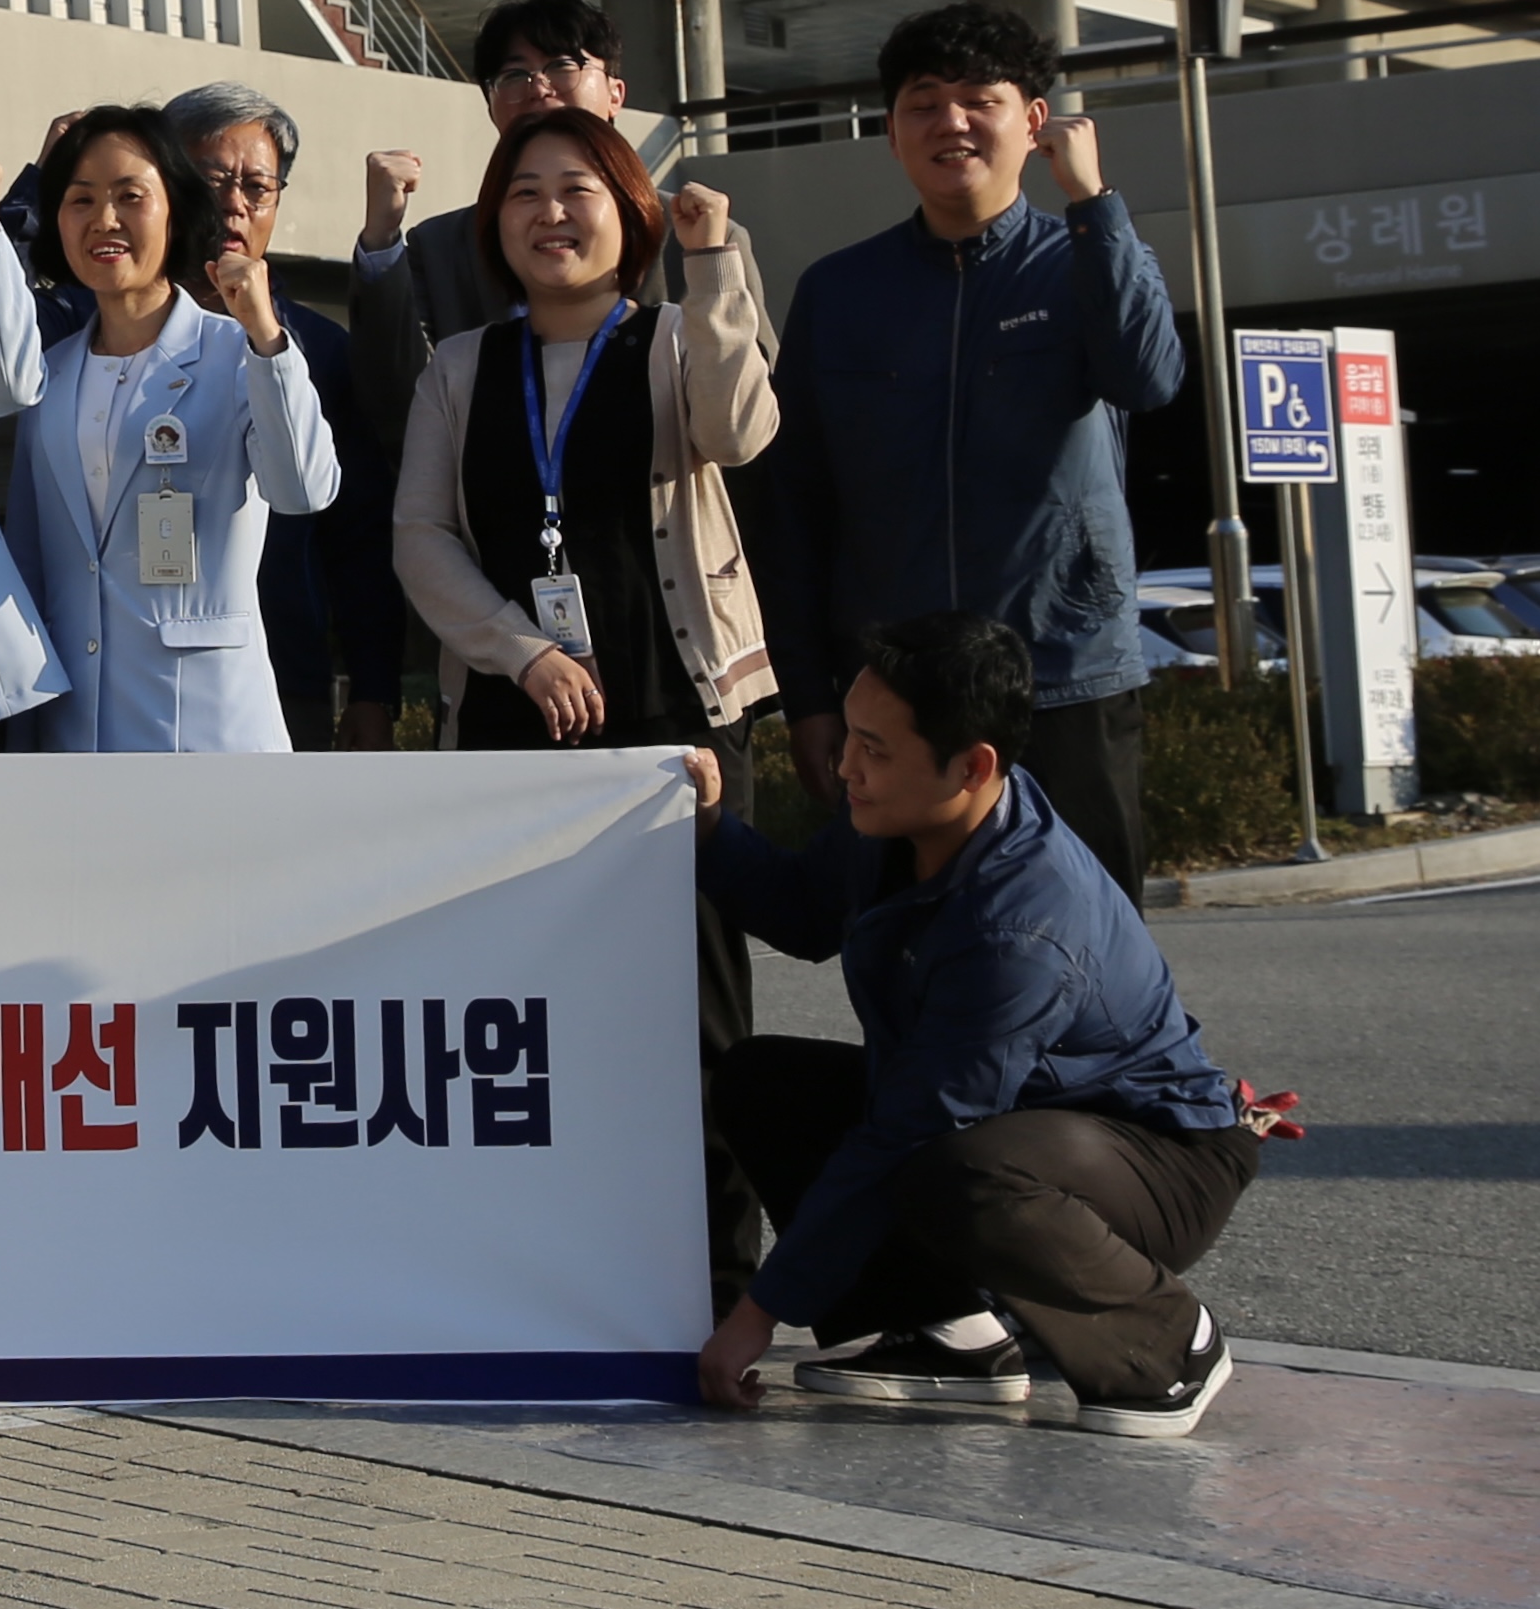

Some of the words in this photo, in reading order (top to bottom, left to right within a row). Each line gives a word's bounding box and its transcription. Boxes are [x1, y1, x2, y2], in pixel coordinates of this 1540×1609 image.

[1305, 191, 1488, 264] 상례원
[1259, 363, 1287, 428] P
[177, 997, 552, 1150] 지원사업
